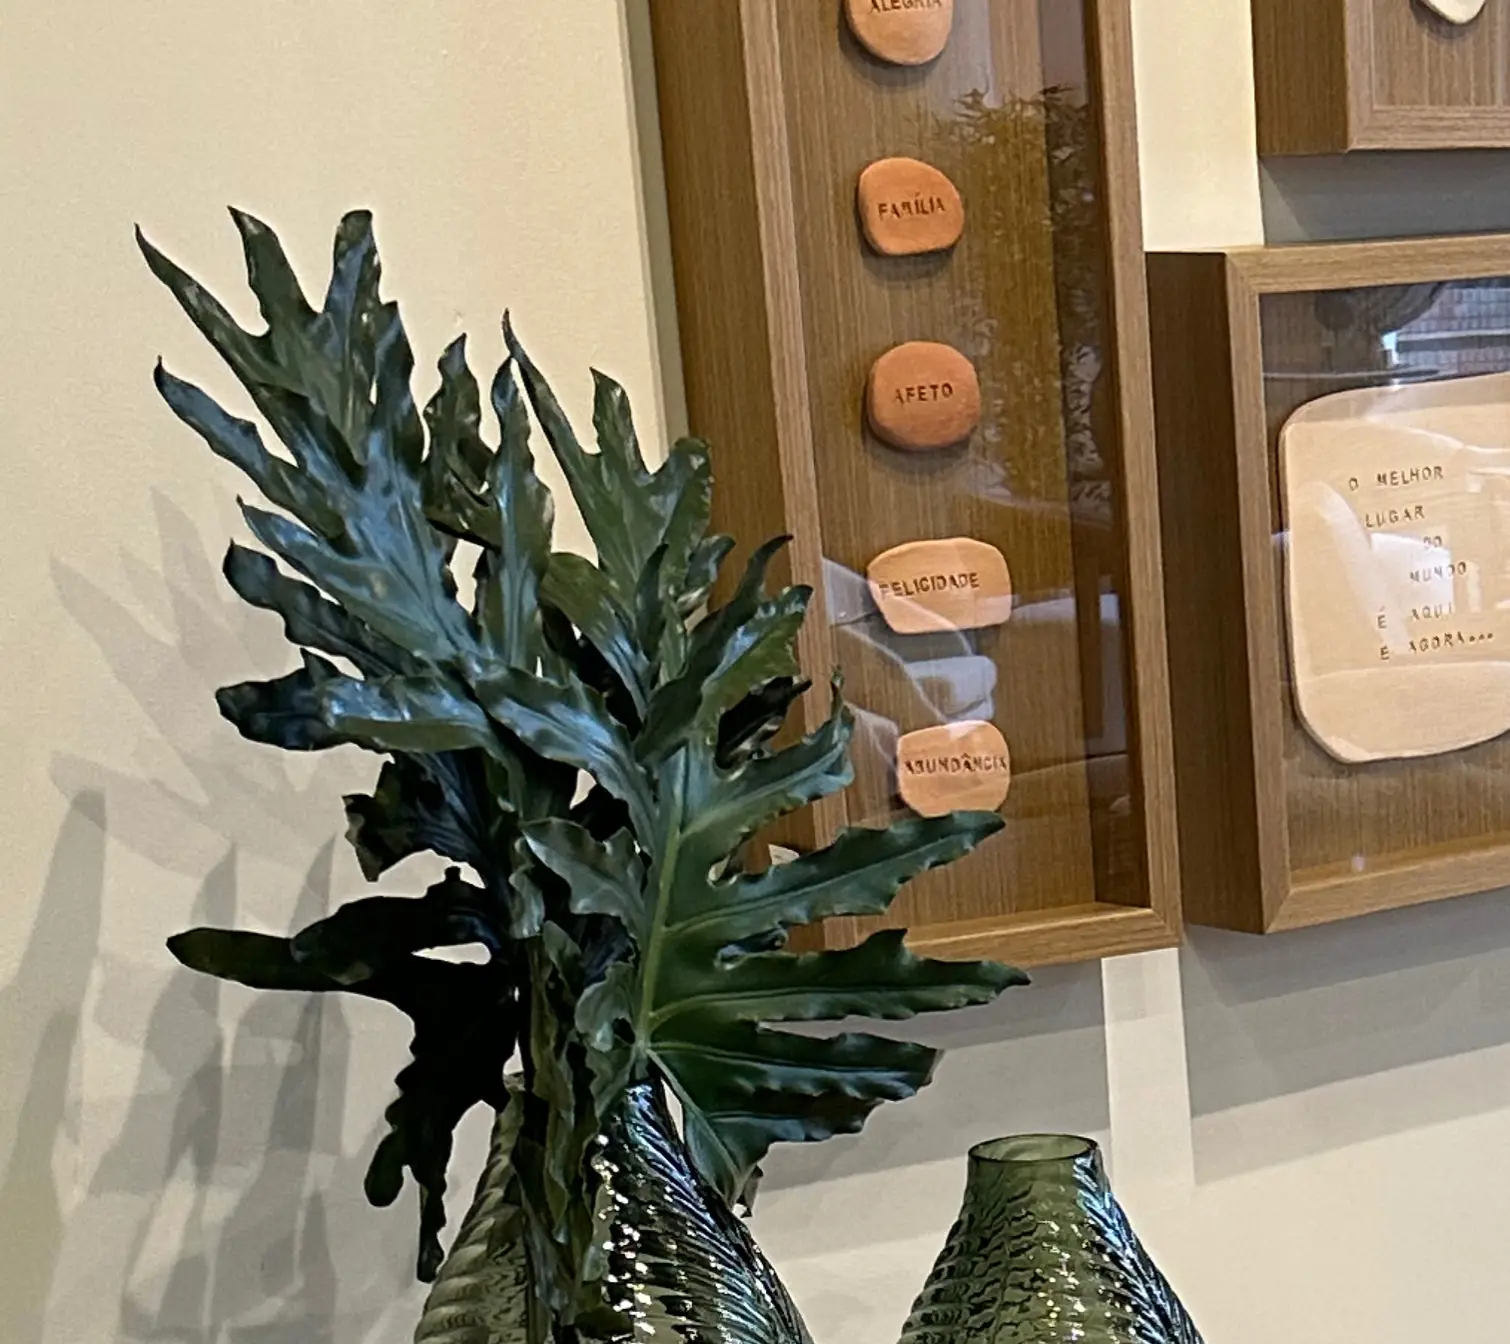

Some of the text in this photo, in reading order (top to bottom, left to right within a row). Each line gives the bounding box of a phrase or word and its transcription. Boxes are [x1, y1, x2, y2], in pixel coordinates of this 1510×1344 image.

[877, 192, 946, 220] FAMÍLIA
[893, 383, 954, 405] AFETO
[1348, 466, 1444, 492] O MELHOR
[1365, 505, 1425, 528] LUGAR
[1409, 561, 1467, 583] MUNDO
[879, 572, 981, 600] FELICIDADE
[1411, 602, 1453, 621] AQUI
[904, 752, 1008, 775] ABUNDÂNCIA
